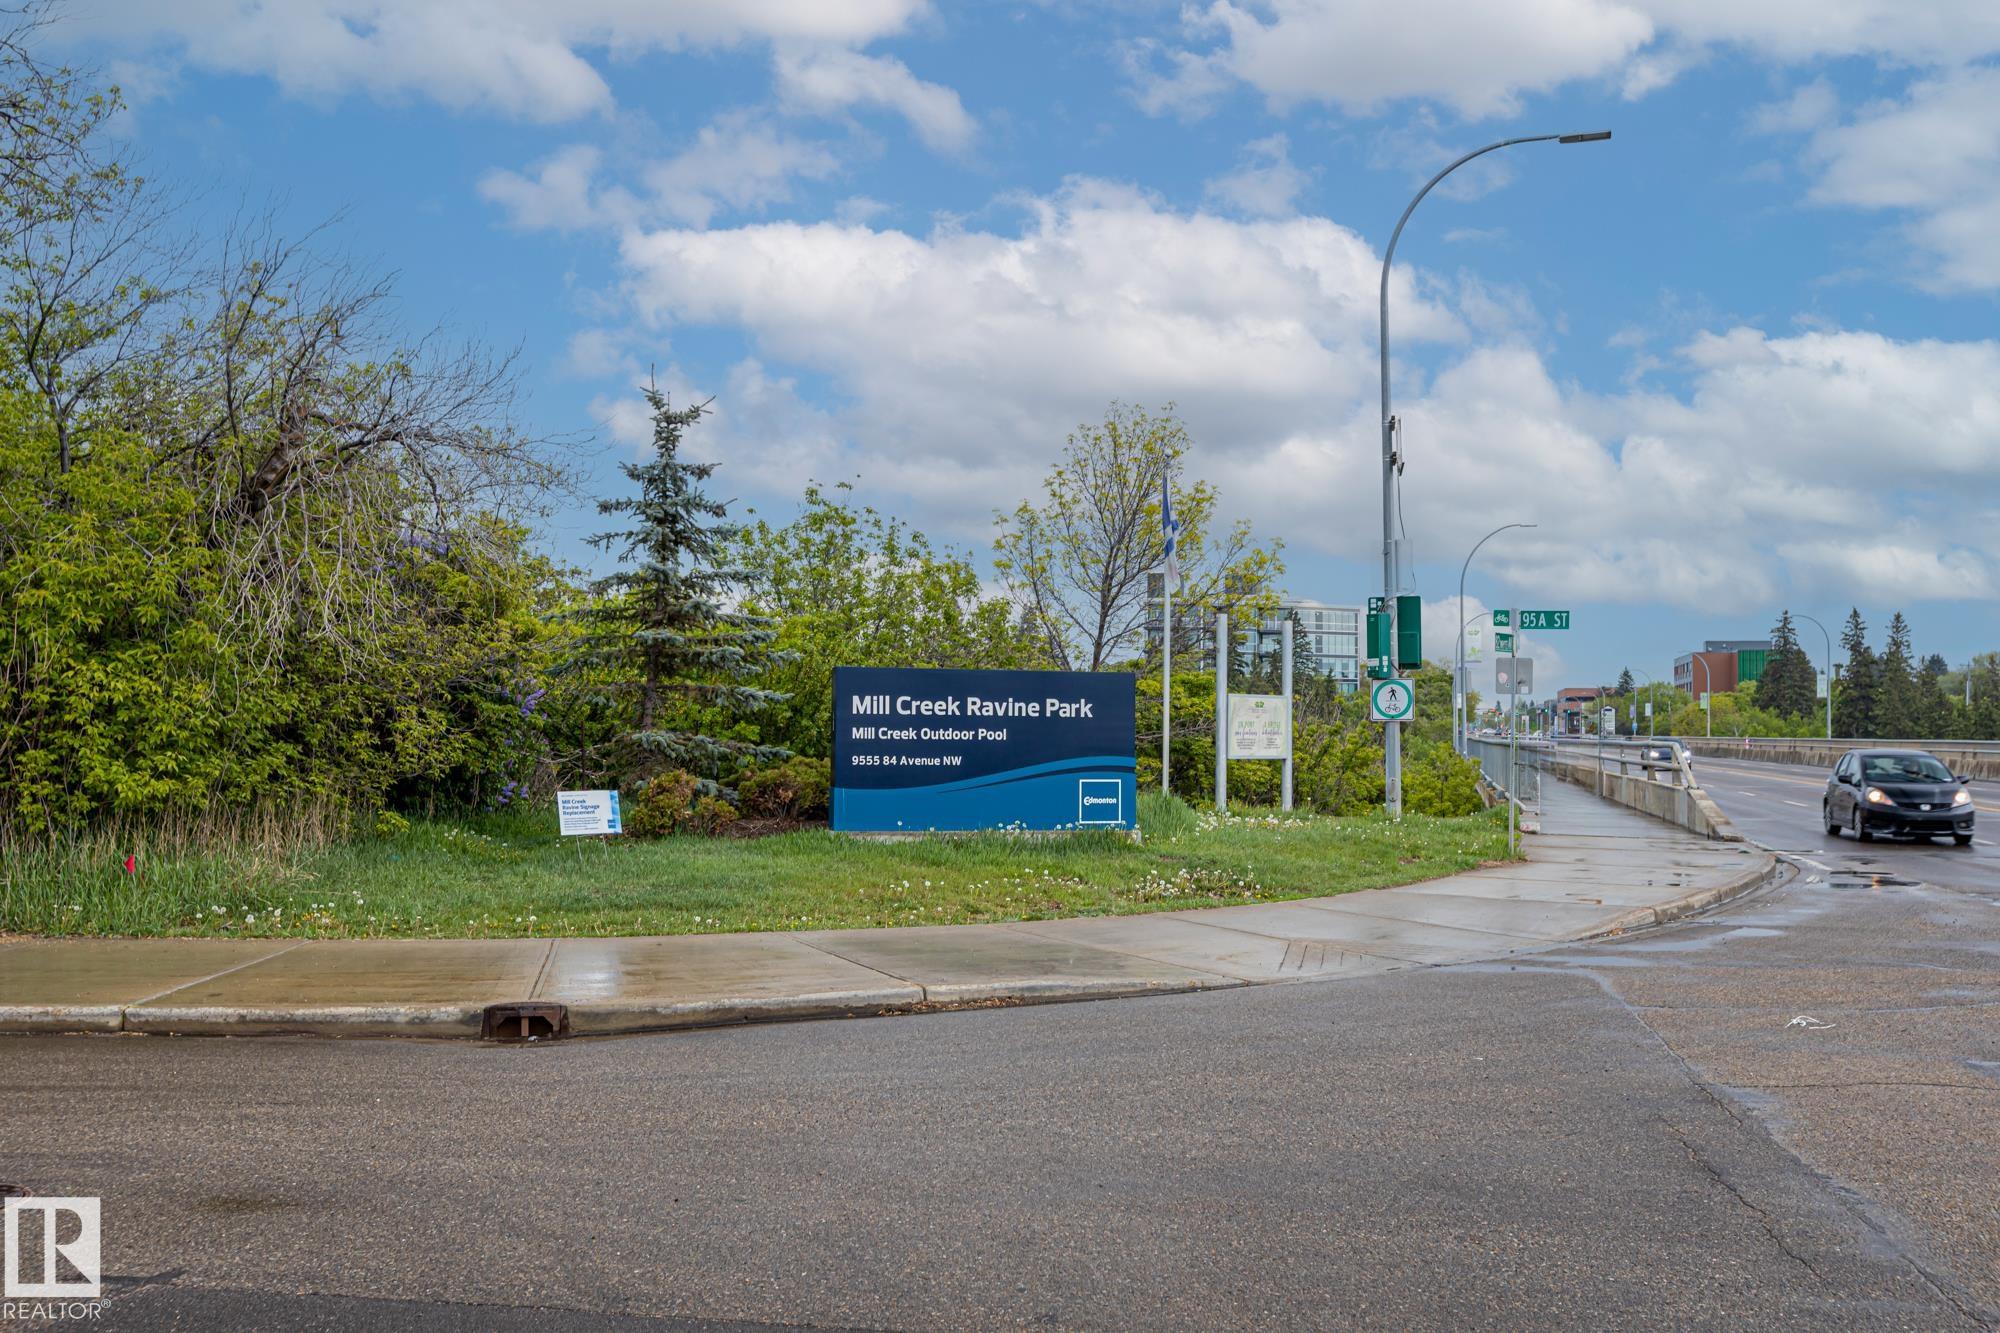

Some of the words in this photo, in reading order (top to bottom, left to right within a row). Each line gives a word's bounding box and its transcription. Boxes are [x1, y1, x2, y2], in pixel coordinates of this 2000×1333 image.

[1522, 613, 1546, 627] 95A
[1554, 613, 1568, 627] ST
[851, 695, 890, 715] Mill
[896, 696, 961, 716] Creek
[967, 697, 1040, 717] Ravine
[1046, 699, 1093, 718] Park
[851, 727, 875, 740] Mill
[878, 728, 917, 740] Creek
[920, 728, 975, 740] Outdoor
[978, 728, 1007, 740] Pool
[851, 755, 880, 766] 9555
[883, 755, 897, 766] 84
[900, 755, 941, 766] Avenue
[943, 755, 962, 766] NW
[1083, 796, 1117, 806] Edmonton
